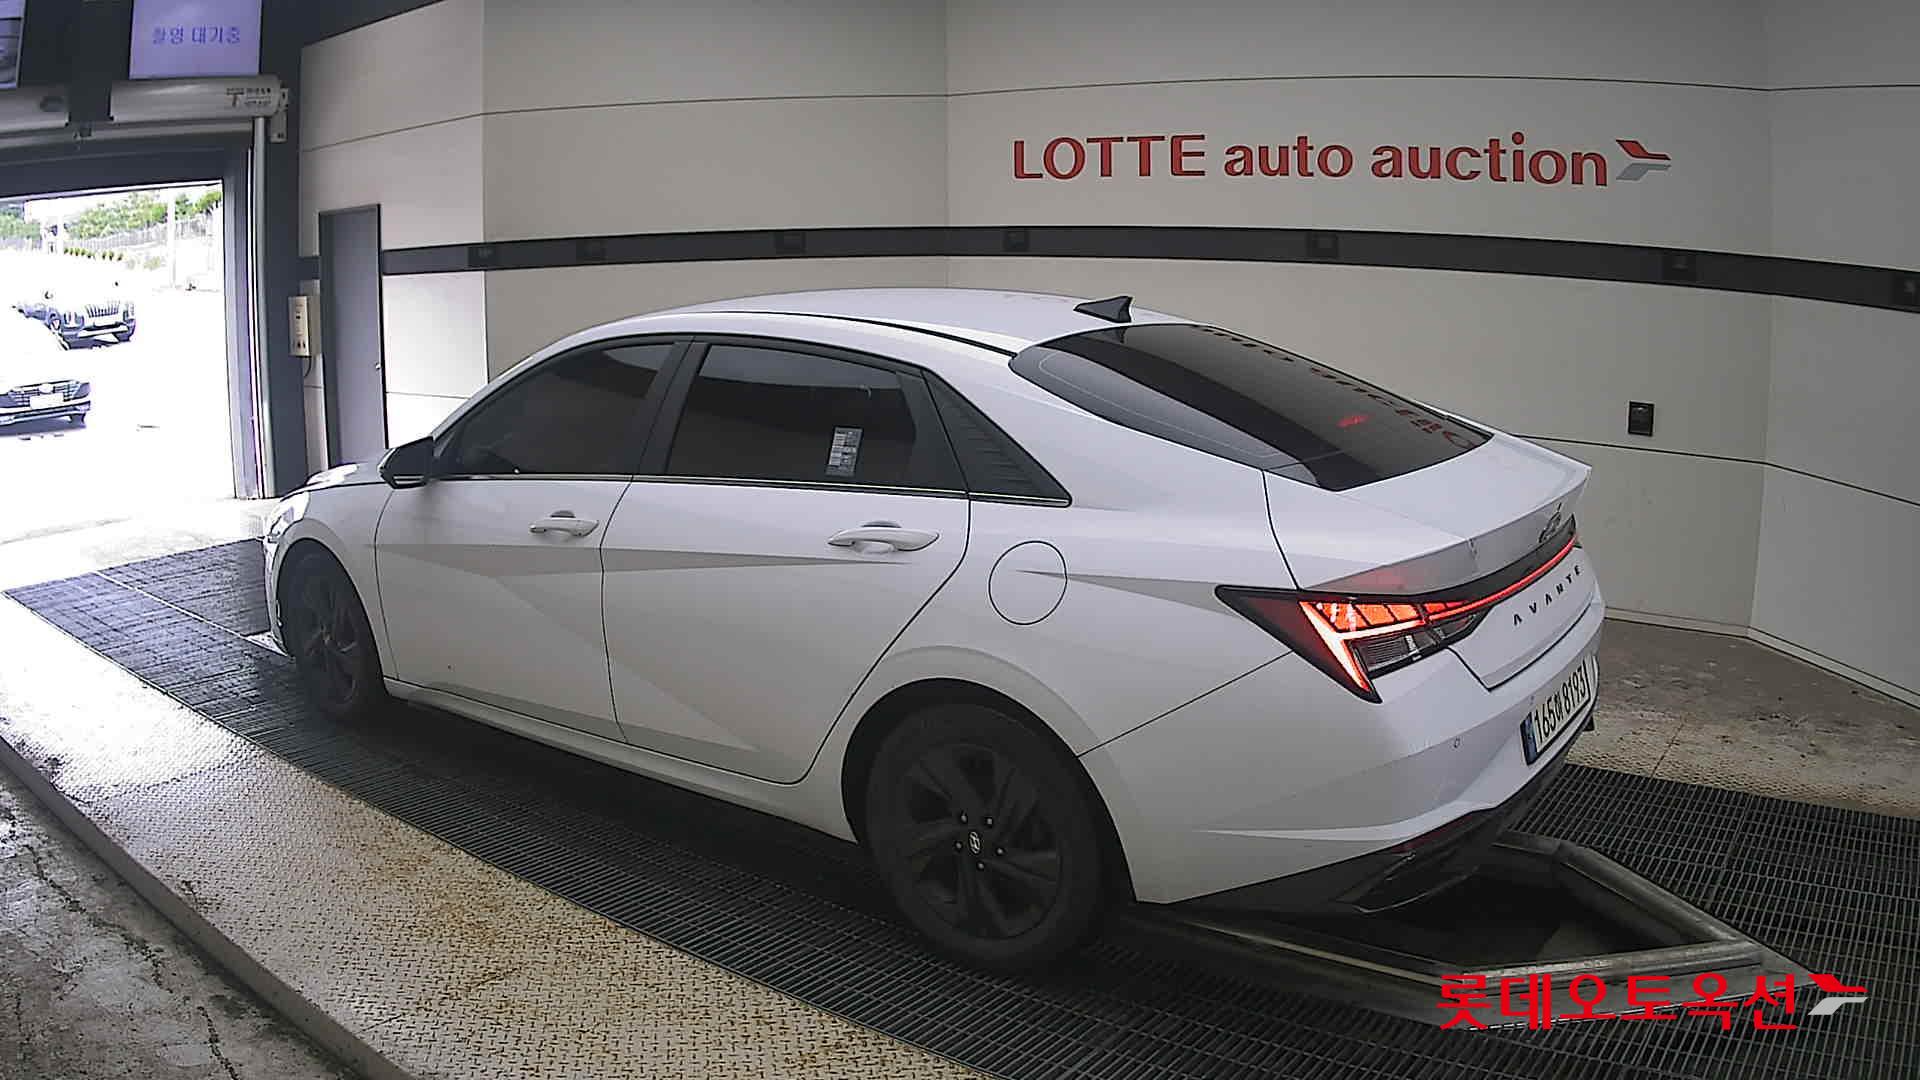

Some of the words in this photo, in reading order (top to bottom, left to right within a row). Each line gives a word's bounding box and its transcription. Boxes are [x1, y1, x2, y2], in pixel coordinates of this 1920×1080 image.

[1013, 133, 1206, 181] LOTTE
[1223, 134, 1354, 178] auto
[1371, 131, 1608, 187] auction
[1513, 564, 1582, 626] AVANTE
